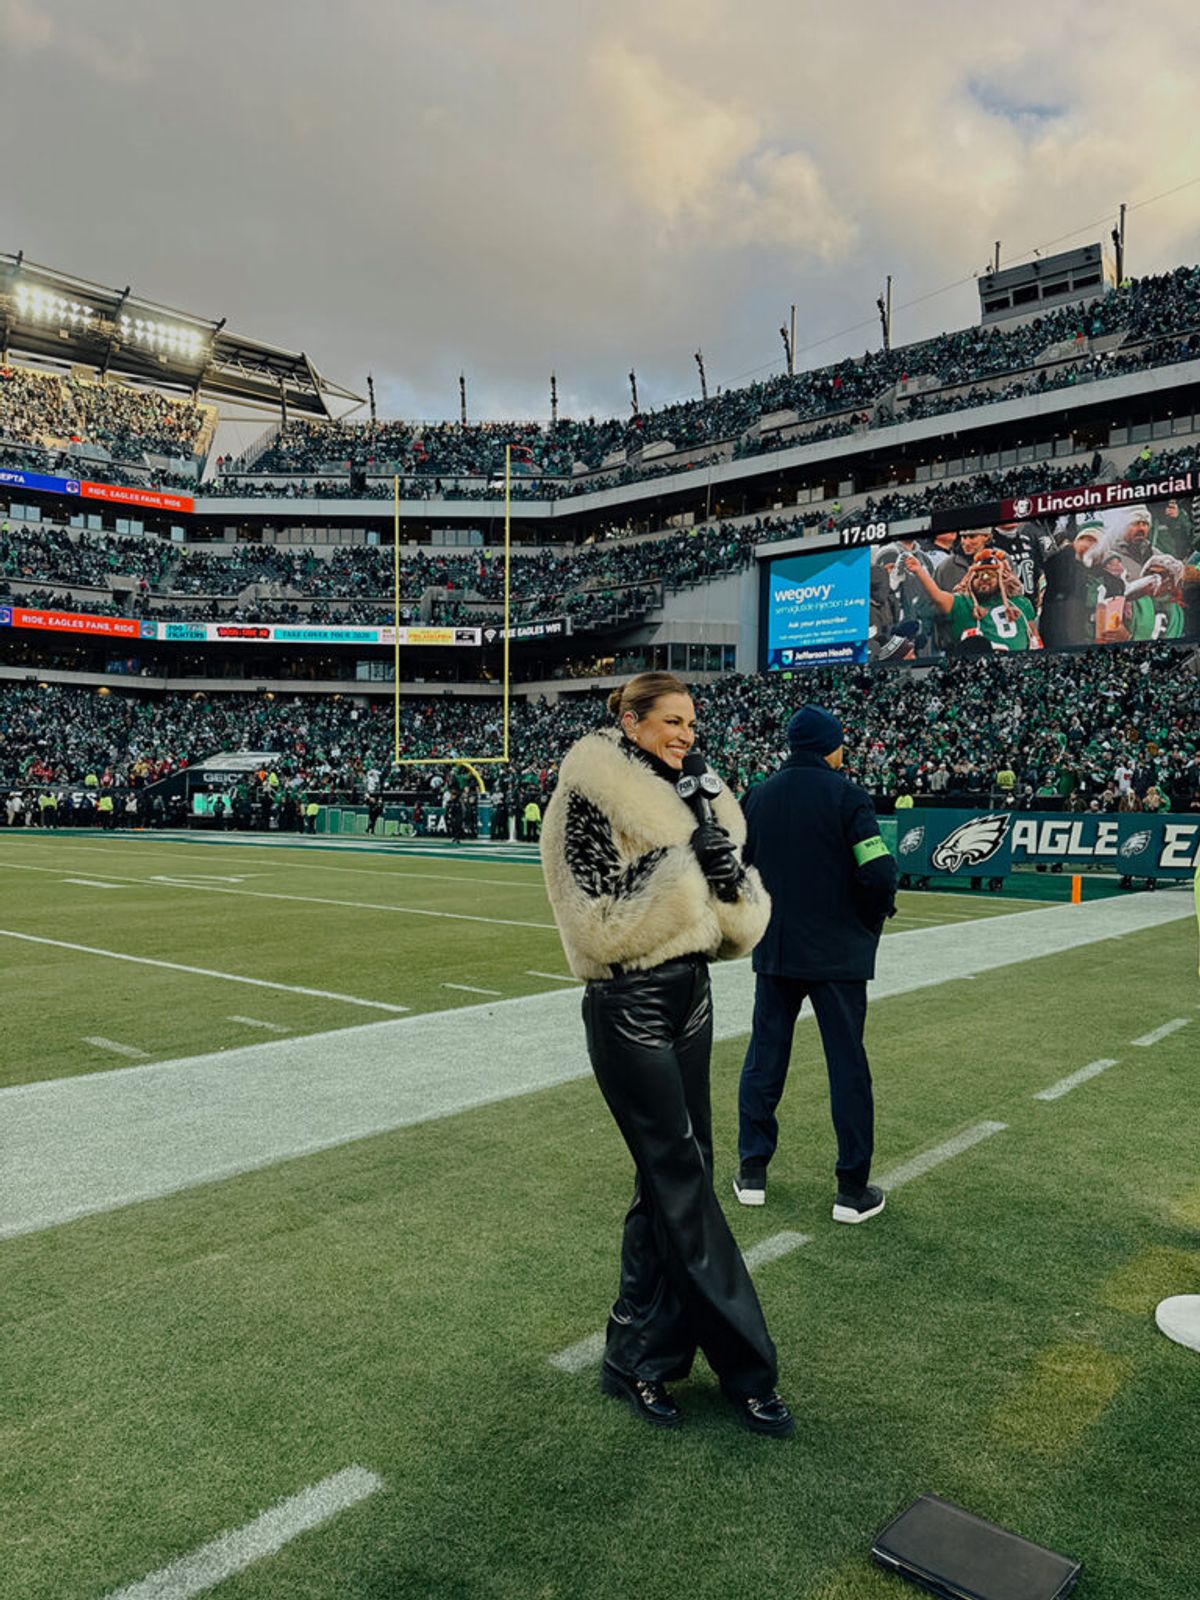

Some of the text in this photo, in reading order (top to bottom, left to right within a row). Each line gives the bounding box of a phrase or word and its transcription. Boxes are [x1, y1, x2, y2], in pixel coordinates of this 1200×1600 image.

[0, 472, 25, 483] EPTA
[110, 490, 139, 501] EAGLES
[1037, 473, 1193, 512] Lincoln Financial
[842, 522, 886, 544] 17:08
[774, 584, 832, 604] wegovy
[22, 614, 134, 633] RIDE, EAGLES FANS, RIDE
[517, 624, 545, 636] EAGLES
[795, 647, 853, 660] Jefferson Health
[203, 772, 242, 783] GEIC
